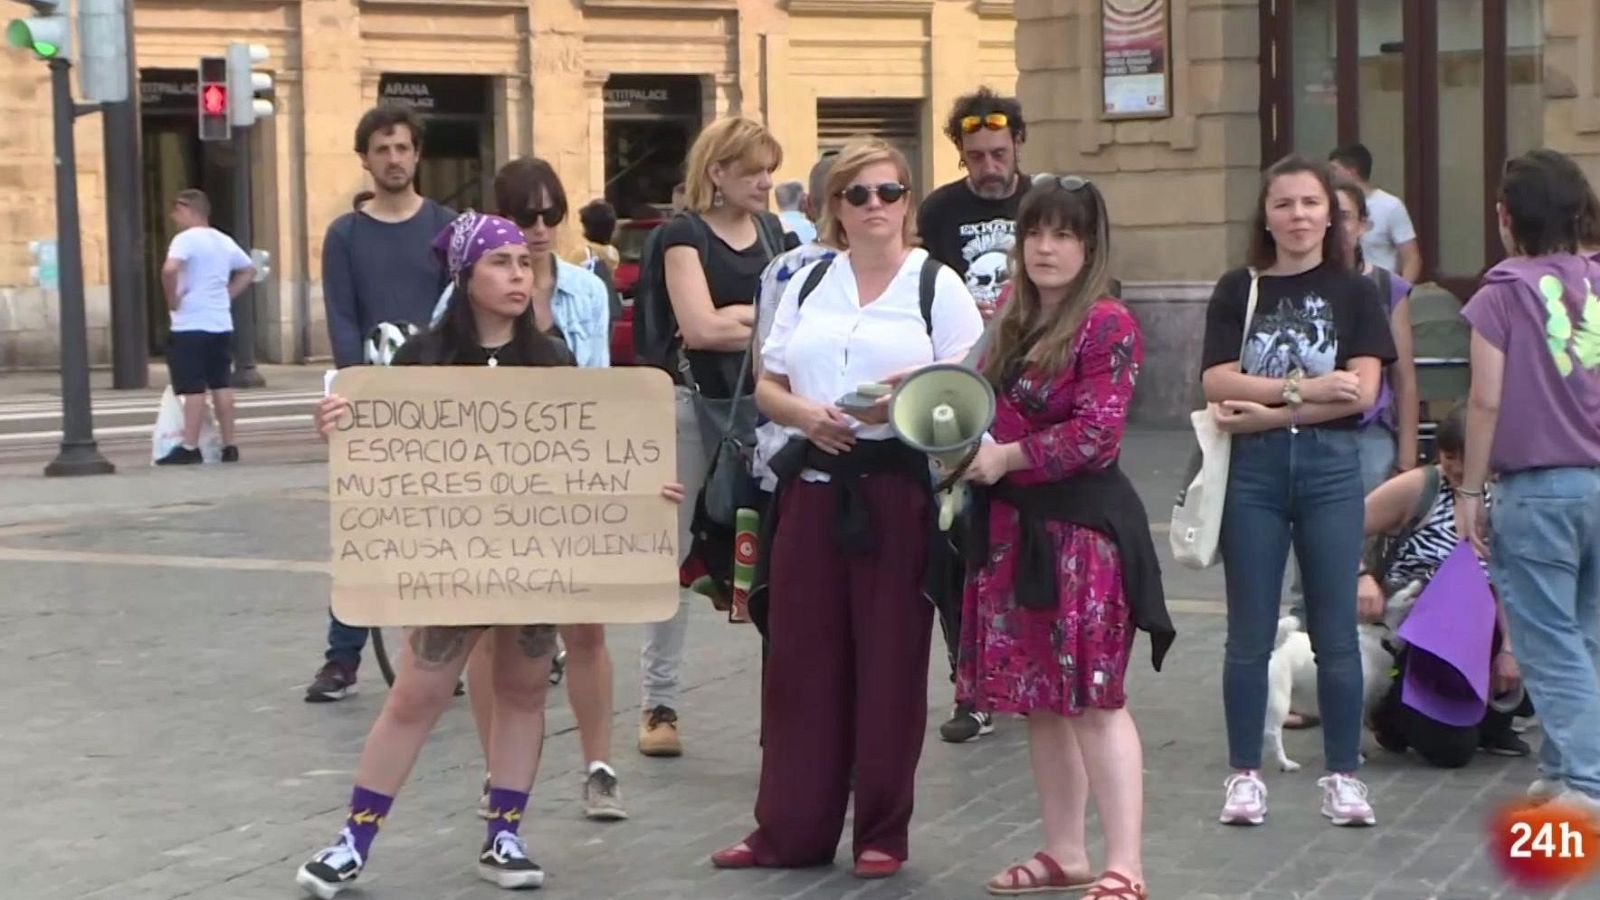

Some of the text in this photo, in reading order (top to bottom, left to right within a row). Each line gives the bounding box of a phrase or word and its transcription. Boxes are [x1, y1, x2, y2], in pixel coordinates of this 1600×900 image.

[384, 82, 430, 95] ARANA
[335, 400, 597, 433] DEDIQUEMOS ESTE
[348, 438, 660, 466] ESPACIO A TODAS LAS
[337, 469, 630, 498] MUJERES QUE HAN
[340, 502, 628, 531] COMETIDO SUICIDIO
[468, 536, 503, 559] DE
[512, 535, 544, 558] LA
[551, 529, 673, 558] VIOLENCIA
[398, 567, 591, 600] PATRIARCAL
